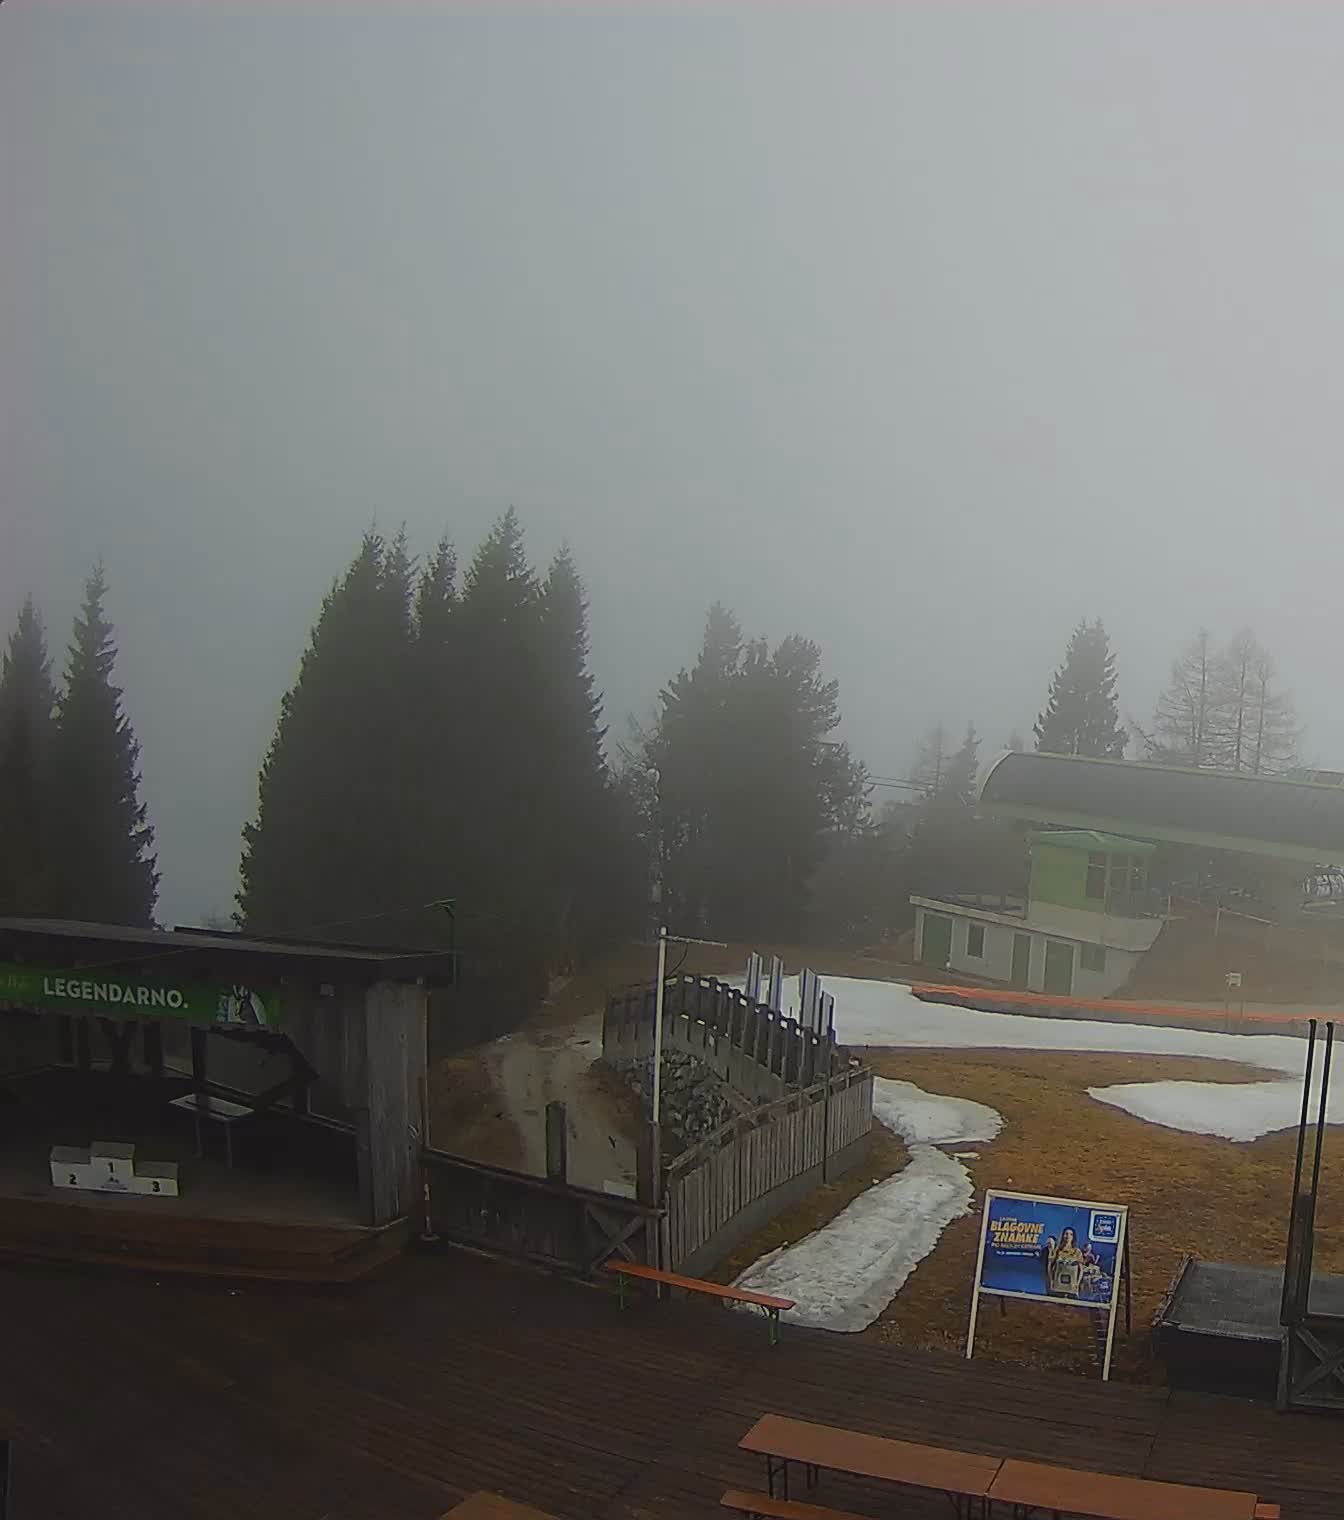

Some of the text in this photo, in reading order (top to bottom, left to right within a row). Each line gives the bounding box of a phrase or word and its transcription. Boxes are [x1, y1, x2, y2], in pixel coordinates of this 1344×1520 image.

[43, 976, 189, 1009] LEGENDARNO.
[108, 1162, 114, 1173] 1
[69, 1174, 77, 1185] 2
[152, 1181, 160, 1192] 3
[990, 1220, 1045, 1234] BLAGOVNE
[993, 1231, 1040, 1244] ZNAMKE
